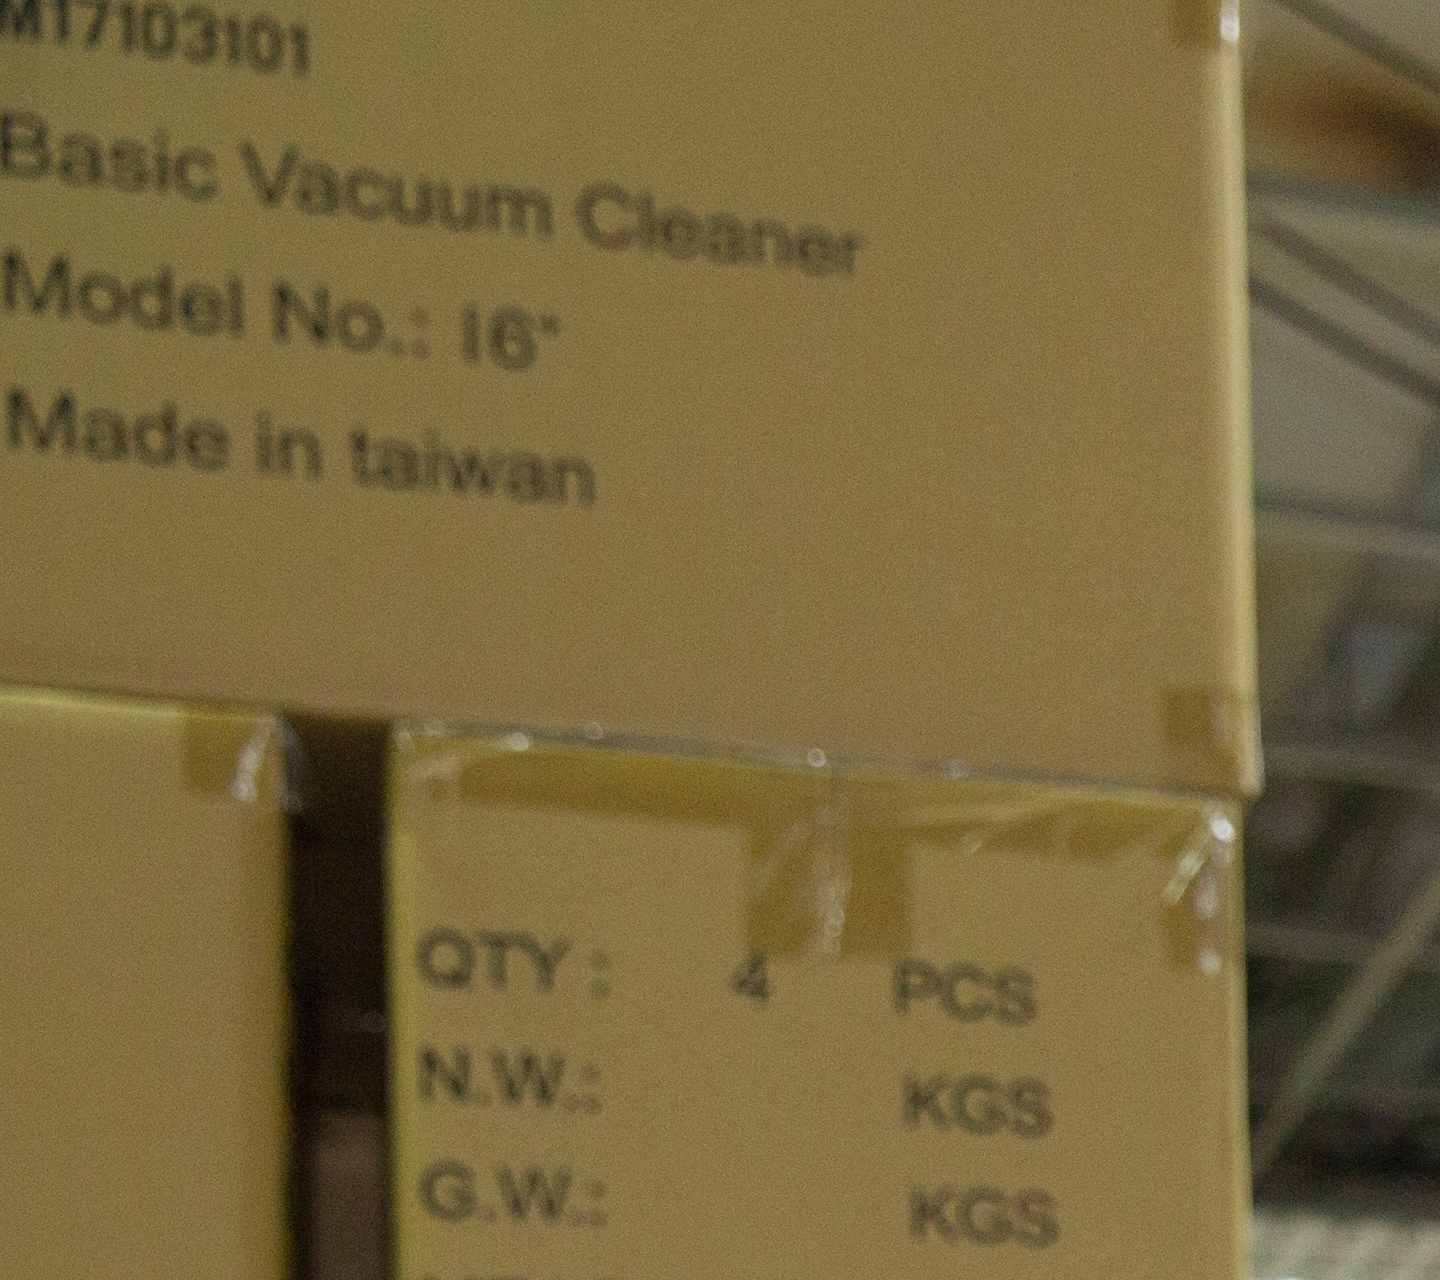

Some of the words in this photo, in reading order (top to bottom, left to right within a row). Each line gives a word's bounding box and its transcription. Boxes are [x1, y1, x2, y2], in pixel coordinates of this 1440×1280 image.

[0, 108, 217, 202] Basic
[238, 140, 554, 237] Vacuum
[573, 182, 862, 278] Cleaner
[0, 247, 245, 336] Model
[4, 385, 230, 472] Made
[254, 412, 324, 479] in
[348, 427, 596, 504] taiwan
[732, 951, 773, 1004] 4
[893, 957, 1038, 1026] PCS
[902, 1074, 1054, 1139] KGS
[909, 1185, 1060, 1249] KGS
